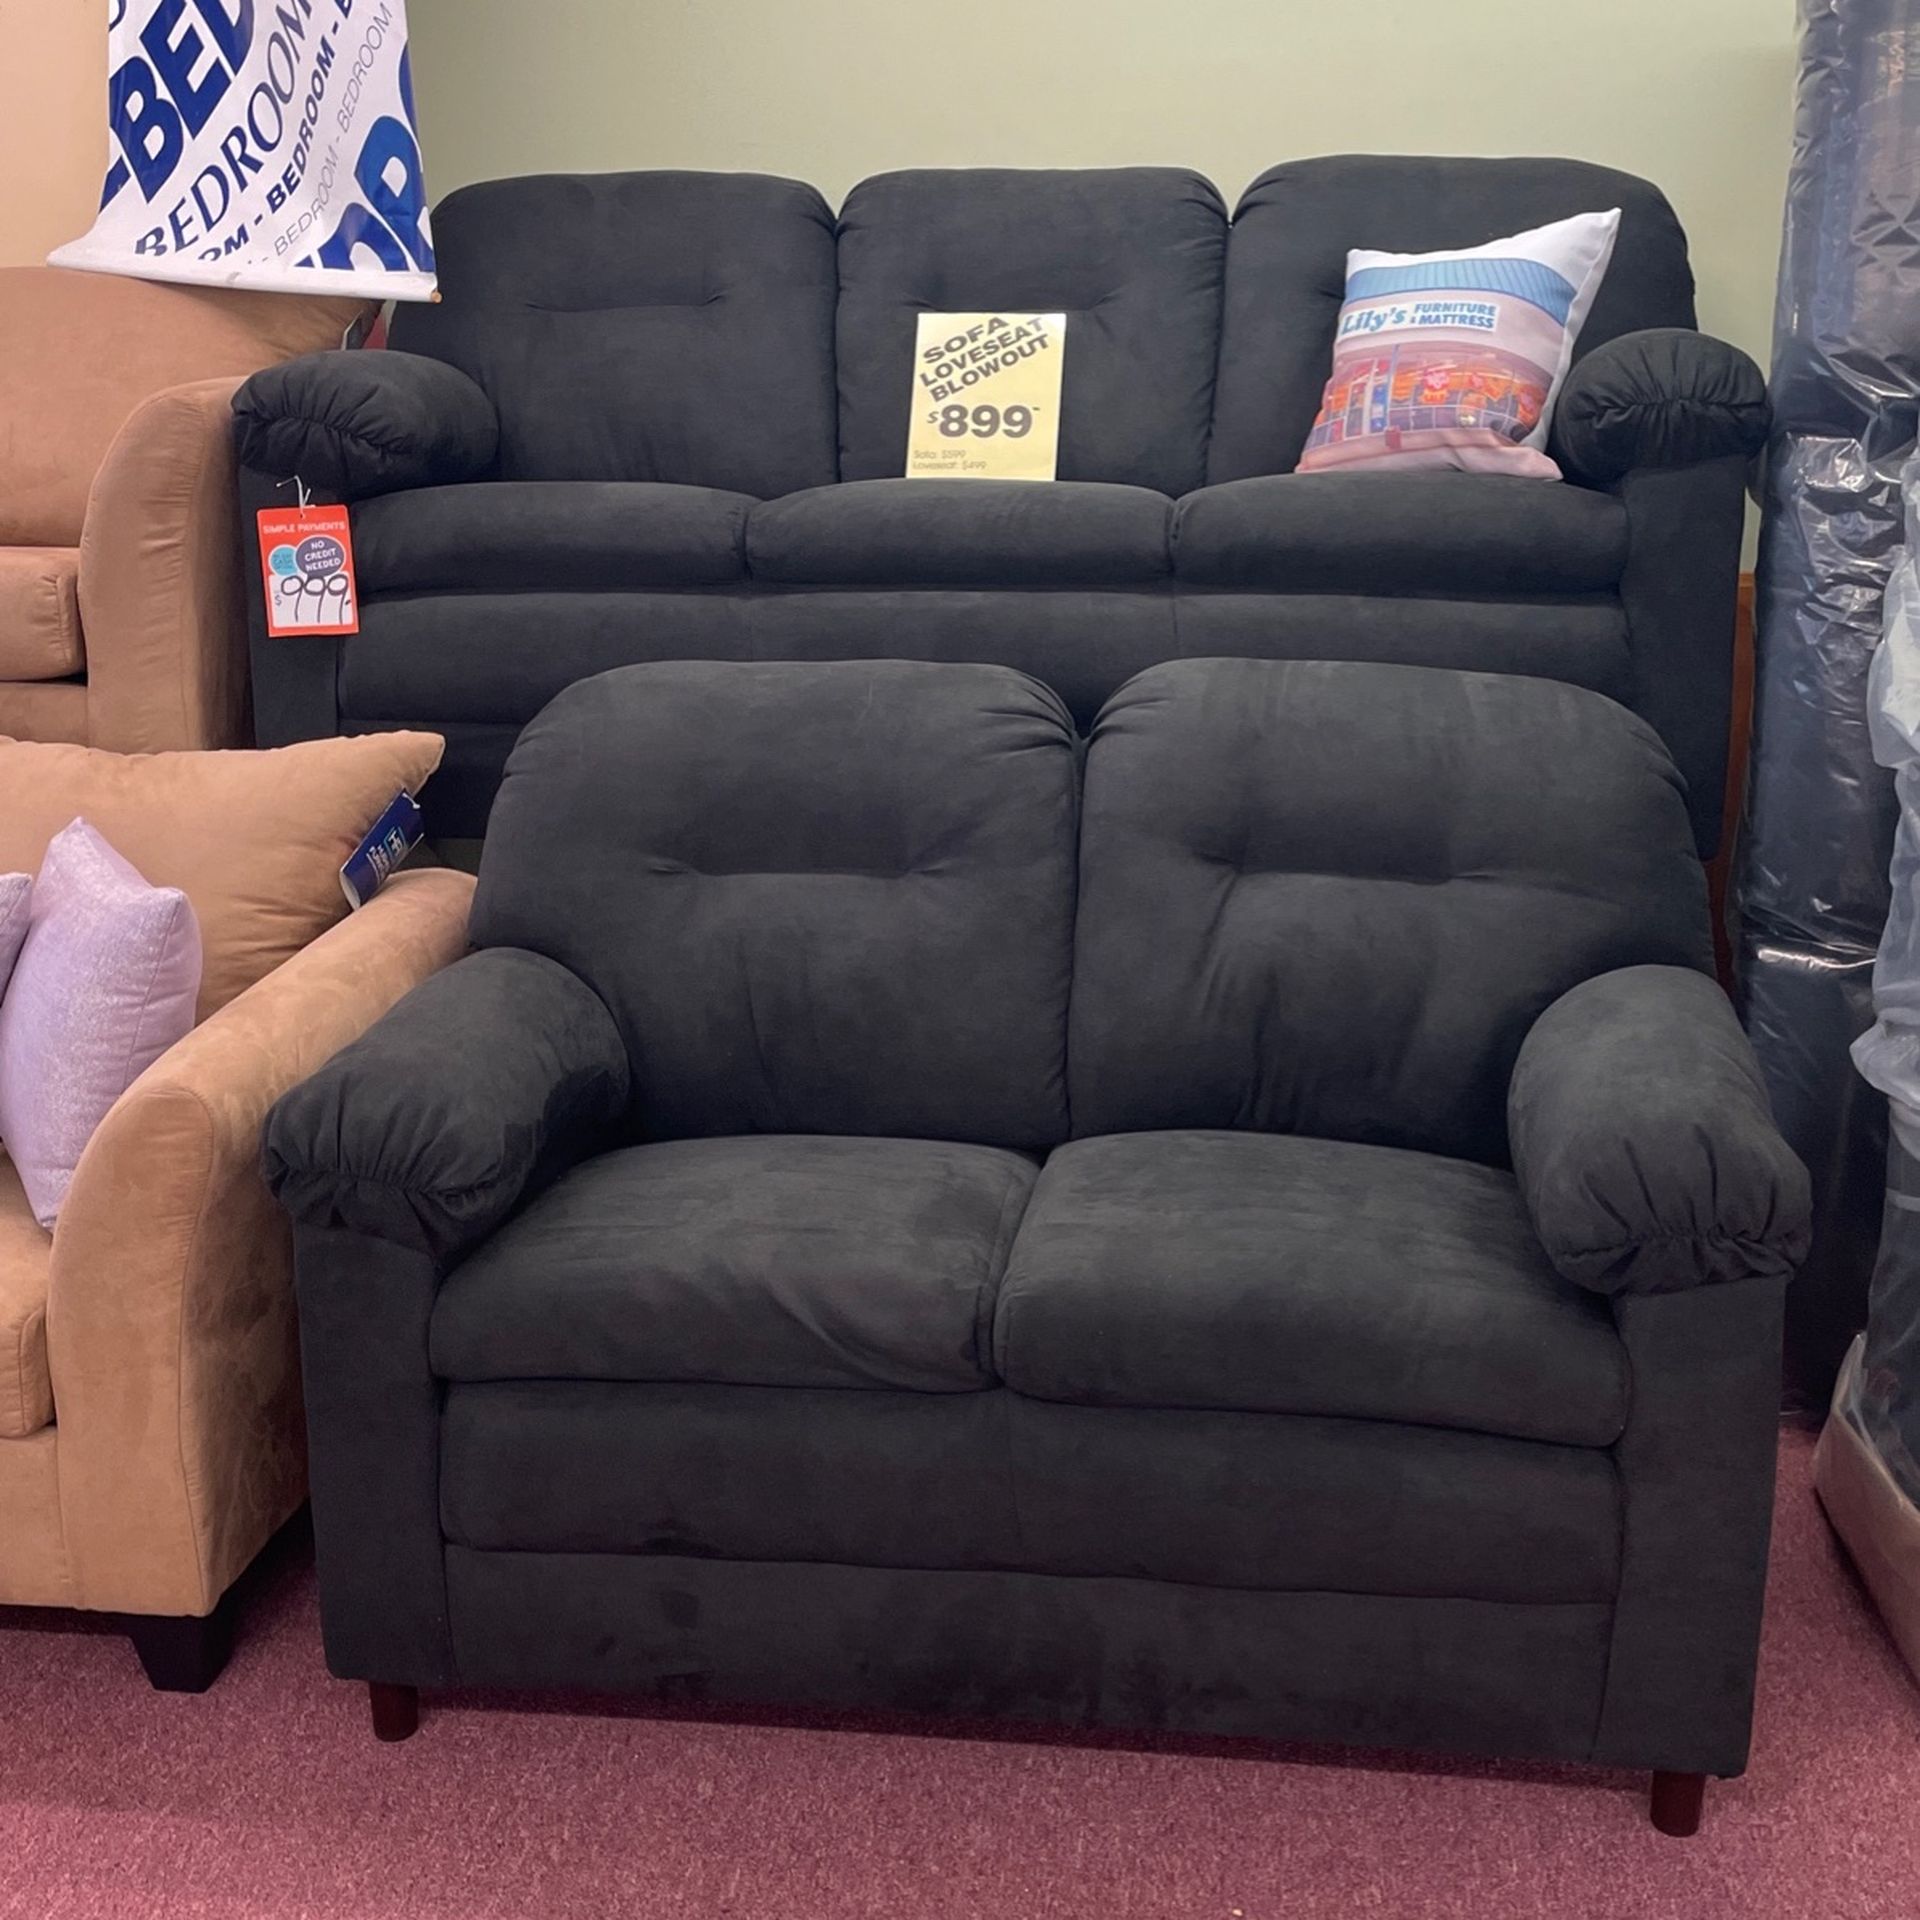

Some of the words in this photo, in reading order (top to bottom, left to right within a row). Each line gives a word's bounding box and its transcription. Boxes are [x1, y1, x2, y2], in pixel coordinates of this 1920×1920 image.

[265, 35, 335, 215] BEDROOM
[273, 147, 338, 257] BEDROOM
[336, 2, 393, 134] BEDROOM
[1341, 307, 1407, 335] Lily's
[1415, 303, 1496, 316] FURNITURE
[1419, 315, 1494, 328] MATTRESS
[919, 317, 1043, 387] LOVESEAT
[923, 316, 1010, 364] SOFA
[929, 333, 1049, 402] BLOWOUT
[297, 520, 345, 533] PAYMENTS
[304, 547, 337, 562] CREDIT
[311, 540, 325, 550] NO
[305, 557, 342, 571] NEEDED
